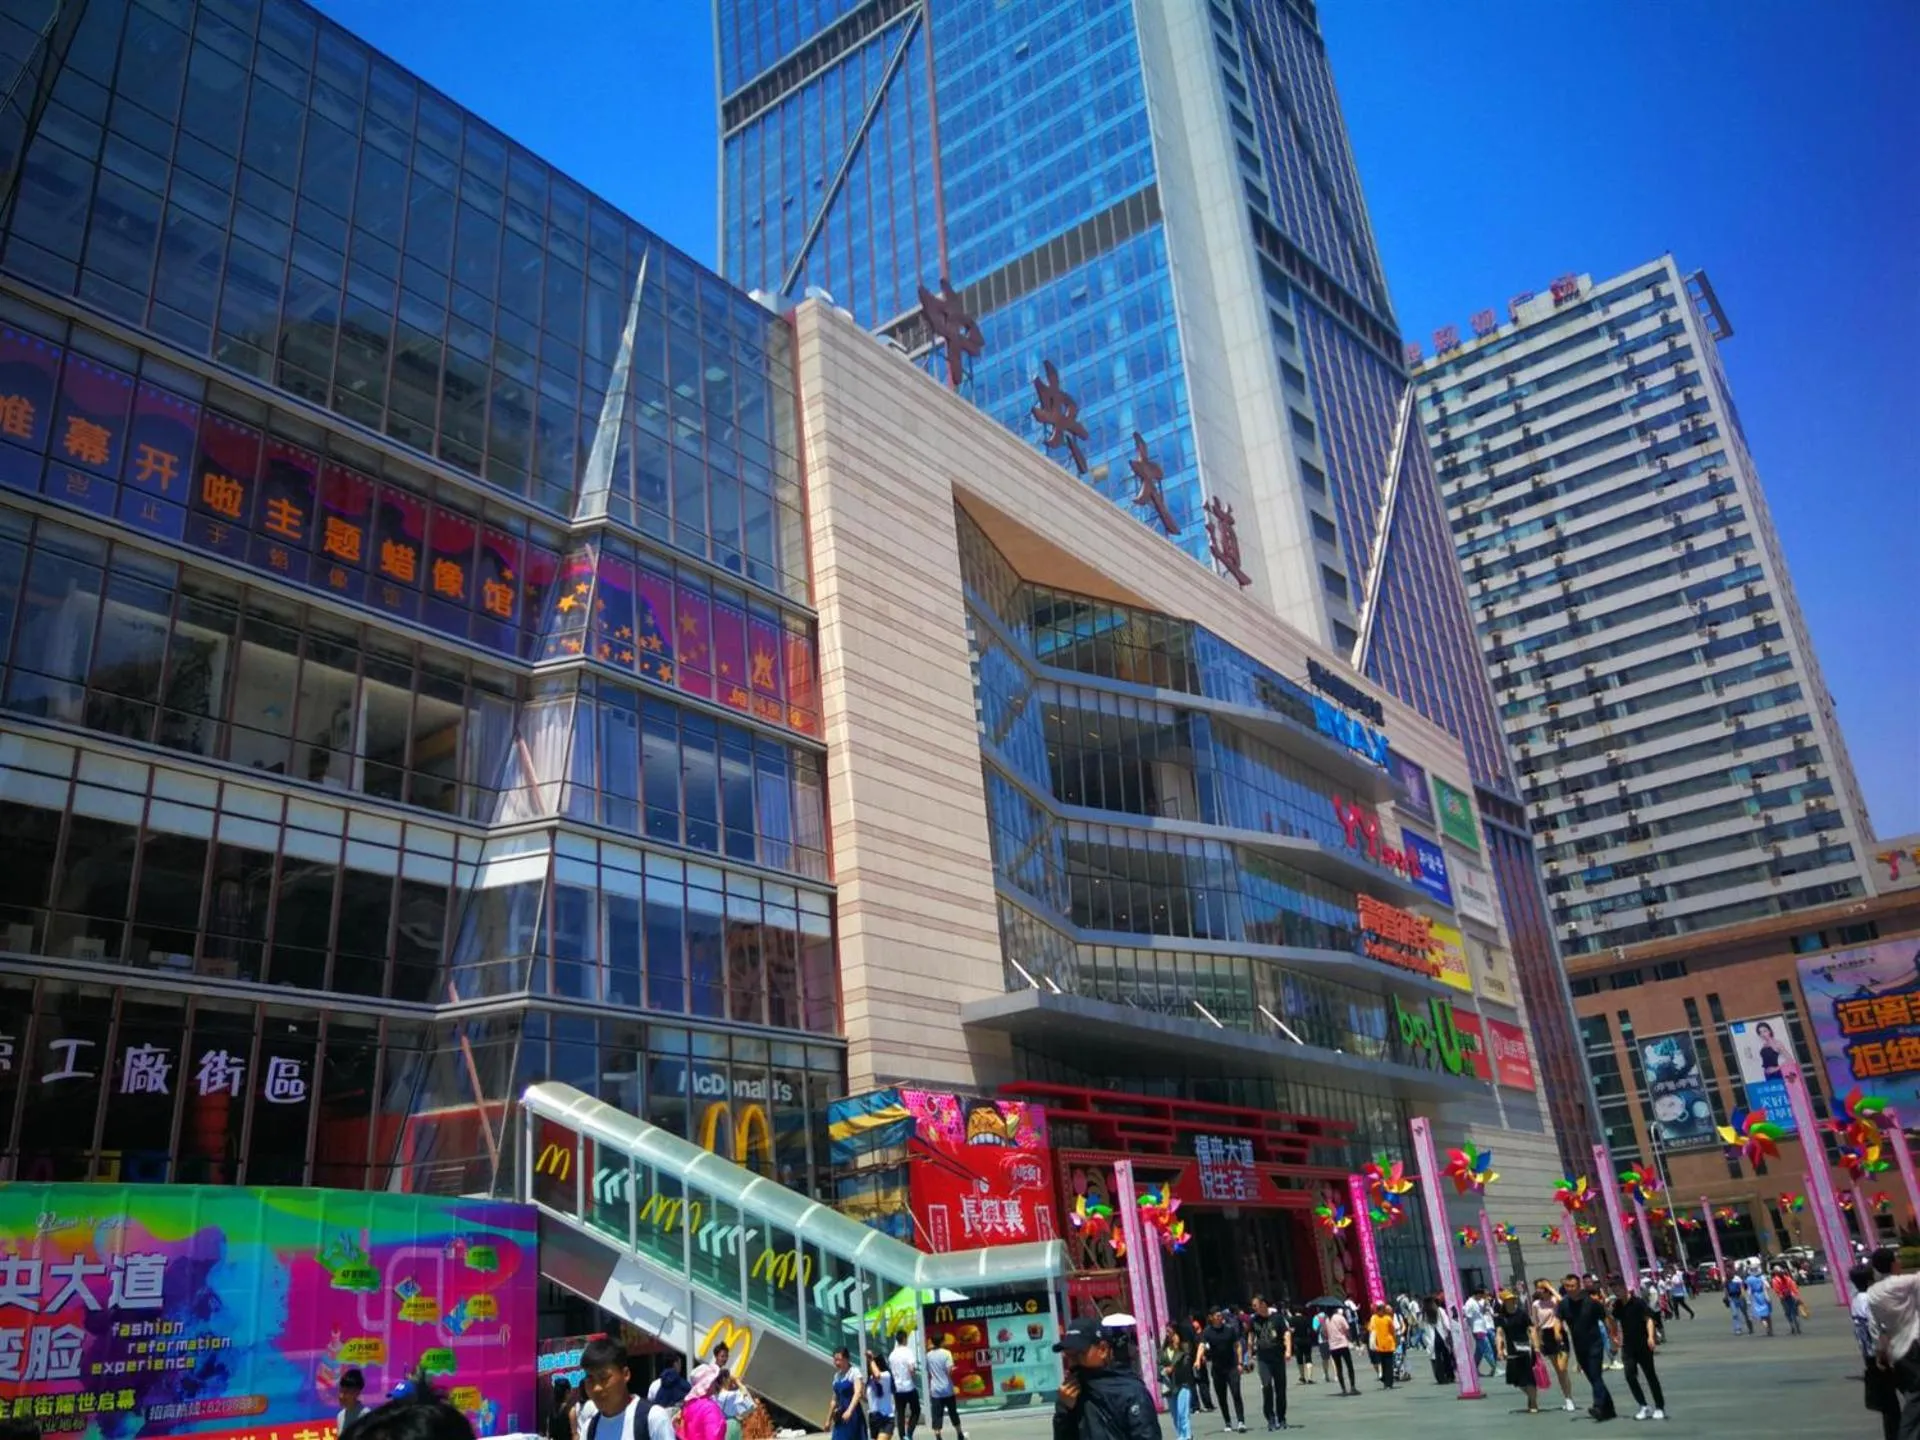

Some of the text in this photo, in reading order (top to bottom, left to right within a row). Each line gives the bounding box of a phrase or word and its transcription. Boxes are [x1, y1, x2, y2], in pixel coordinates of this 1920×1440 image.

[1837, 991, 1920, 1034] 远离
[112, 1319, 184, 1337] fashion
[128, 1335, 231, 1355] reformation
[91, 1356, 196, 1377] experience
